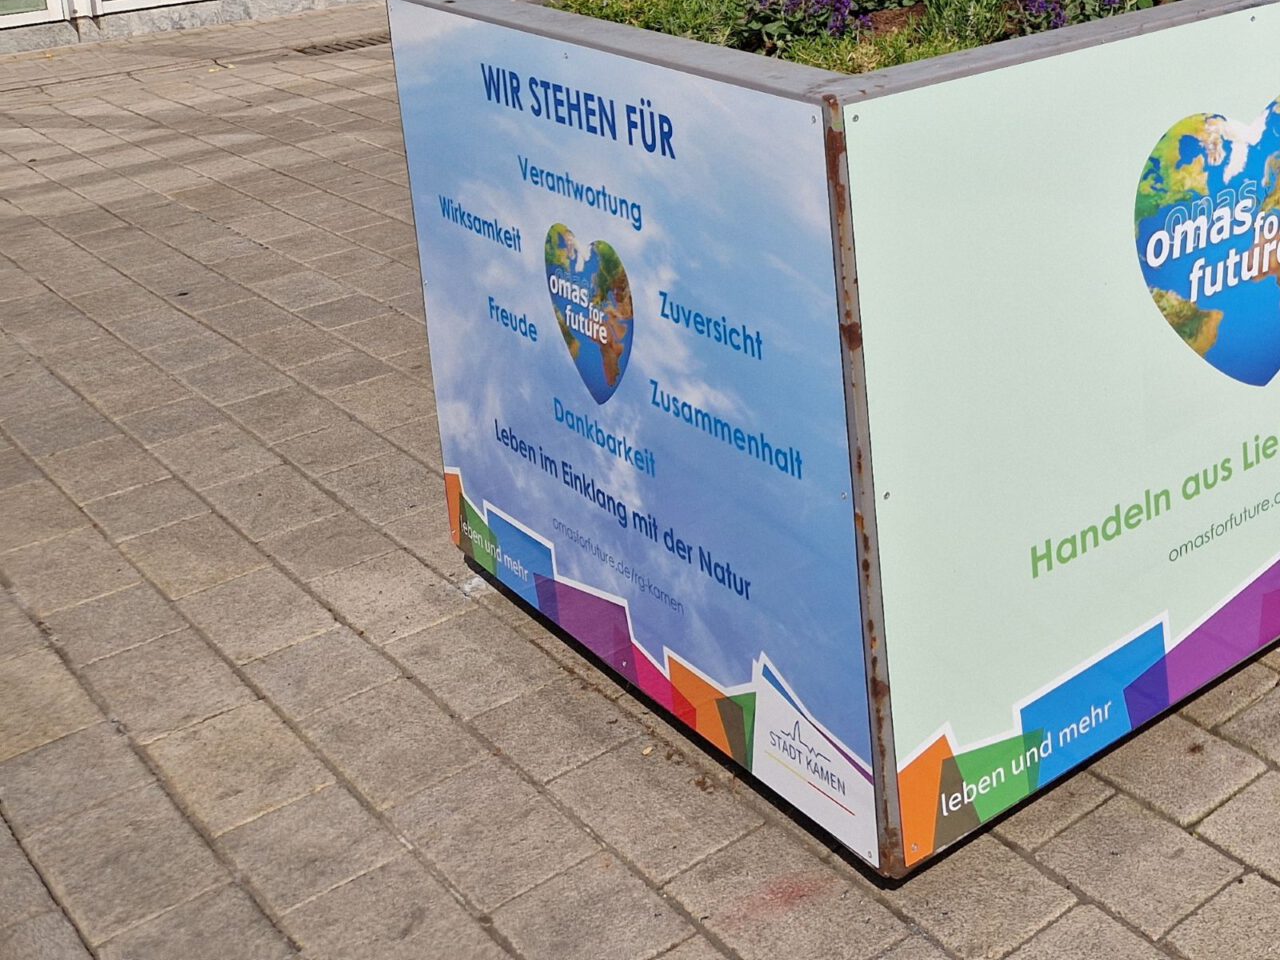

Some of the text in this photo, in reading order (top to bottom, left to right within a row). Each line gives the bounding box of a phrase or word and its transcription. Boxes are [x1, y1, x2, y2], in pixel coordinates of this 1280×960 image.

[480, 63, 676, 160] WIR STEHEN FÜR
[439, 195, 522, 253] Wirksamkeit
[518, 154, 642, 231] Verantwortung
[1146, 199, 1252, 268] omas
[488, 297, 538, 342] Freude
[550, 275, 589, 308] omas
[589, 302, 605, 324] for
[566, 305, 608, 344] future
[658, 291, 763, 360] Zuversicht
[554, 397, 656, 477] Dankbarkeit
[650, 379, 803, 480] Zusammenhalt
[494, 419, 751, 600] Leben im Einklang mit der Natur
[1030, 488, 1171, 579] Handeln
[1182, 457, 1232, 501] aus
[460, 514, 529, 582] leben und mehr
[552, 517, 684, 614] omasforfuture.de/rg-kamen
[769, 731, 846, 797] STADT KAMEN
[940, 701, 1112, 817] leben und mehr
